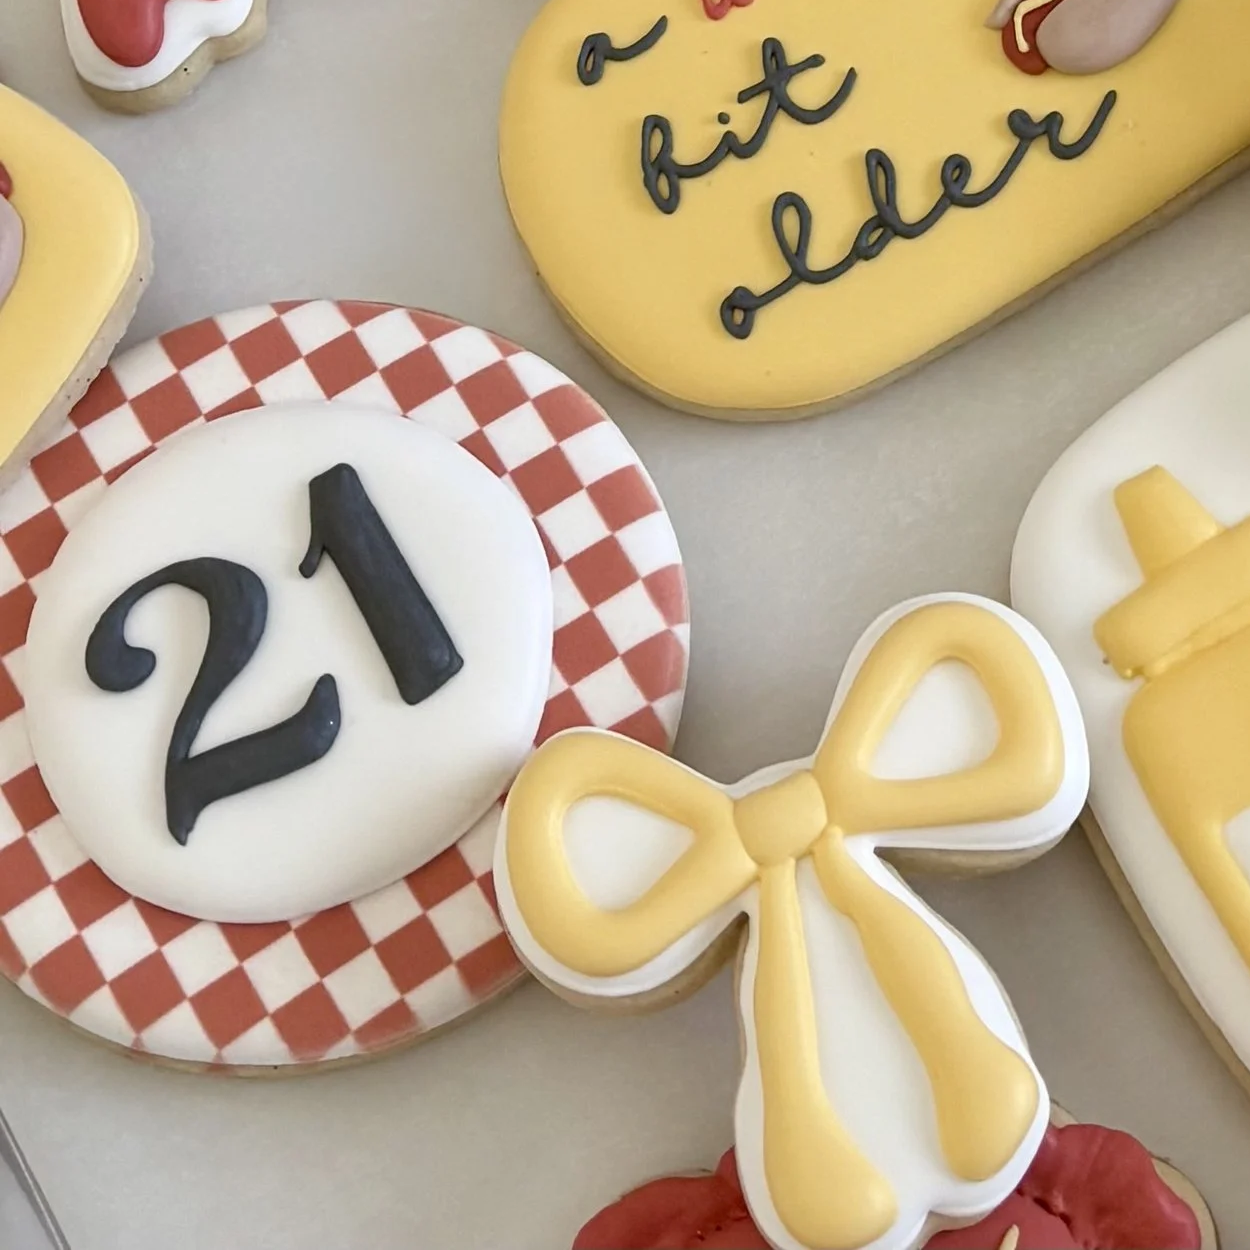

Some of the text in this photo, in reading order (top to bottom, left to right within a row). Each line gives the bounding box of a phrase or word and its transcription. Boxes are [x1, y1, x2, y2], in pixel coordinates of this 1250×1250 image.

[576, 14, 669, 85] a
[641, 37, 858, 214] bit
[719, 89, 1117, 340] older
[85, 462, 465, 847] 21
